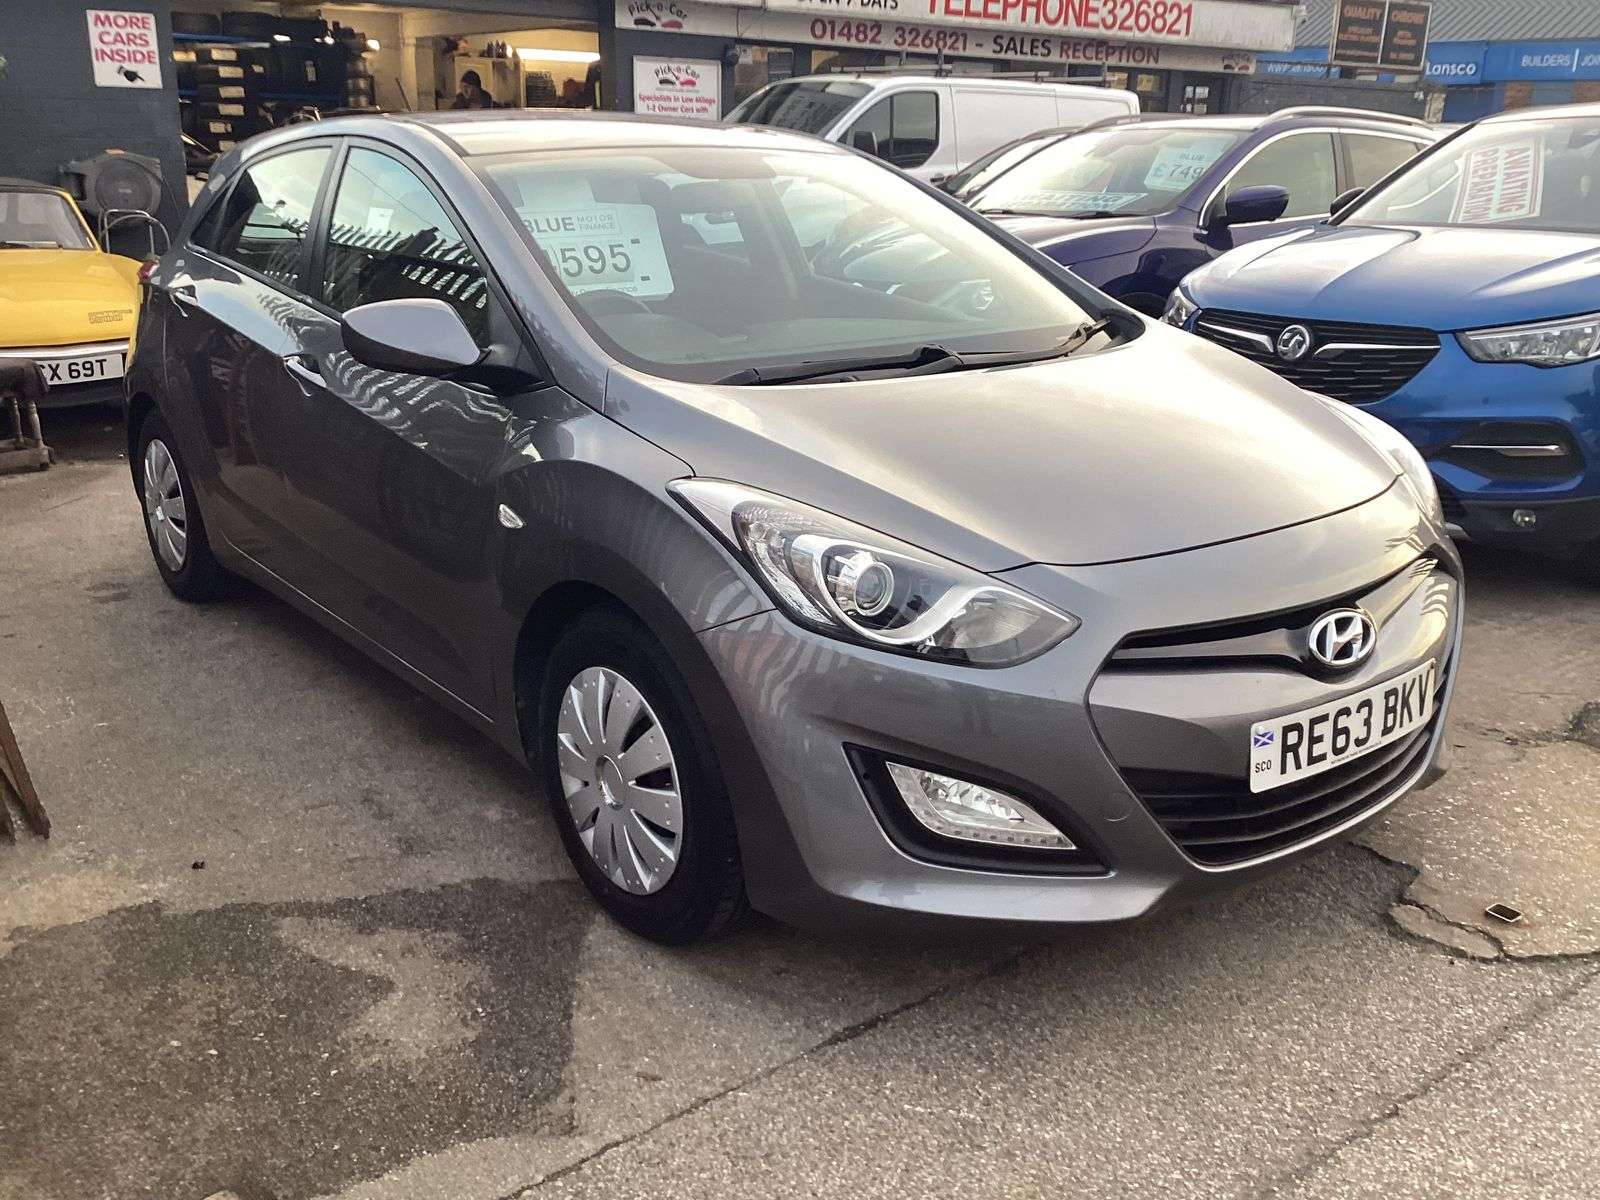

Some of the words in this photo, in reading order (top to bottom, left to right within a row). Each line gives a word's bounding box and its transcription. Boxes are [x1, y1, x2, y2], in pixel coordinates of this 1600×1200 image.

[94, 14, 150, 29] MORE
[98, 31, 149, 47] CARS
[810, 18, 882, 44] 01482
[894, 26, 967, 52] 326821
[991, 36, 1052, 57] SALES
[1059, 42, 1159, 65] RECEPTION
[94, 48, 157, 64] INSIDE
[1521, 53, 1570, 68] BUILDERS
[1425, 62, 1477, 76] Lansco
[1497, 146, 1531, 214] AWAITING
[523, 217, 576, 233] BLUE
[542, 244, 632, 278] 595
[41, 363, 62, 381] X
[68, 359, 107, 379] 69T
[1280, 698, 1374, 776] RE63
[1381, 669, 1431, 738] BKV
[1254, 759, 1272, 774] SCO
